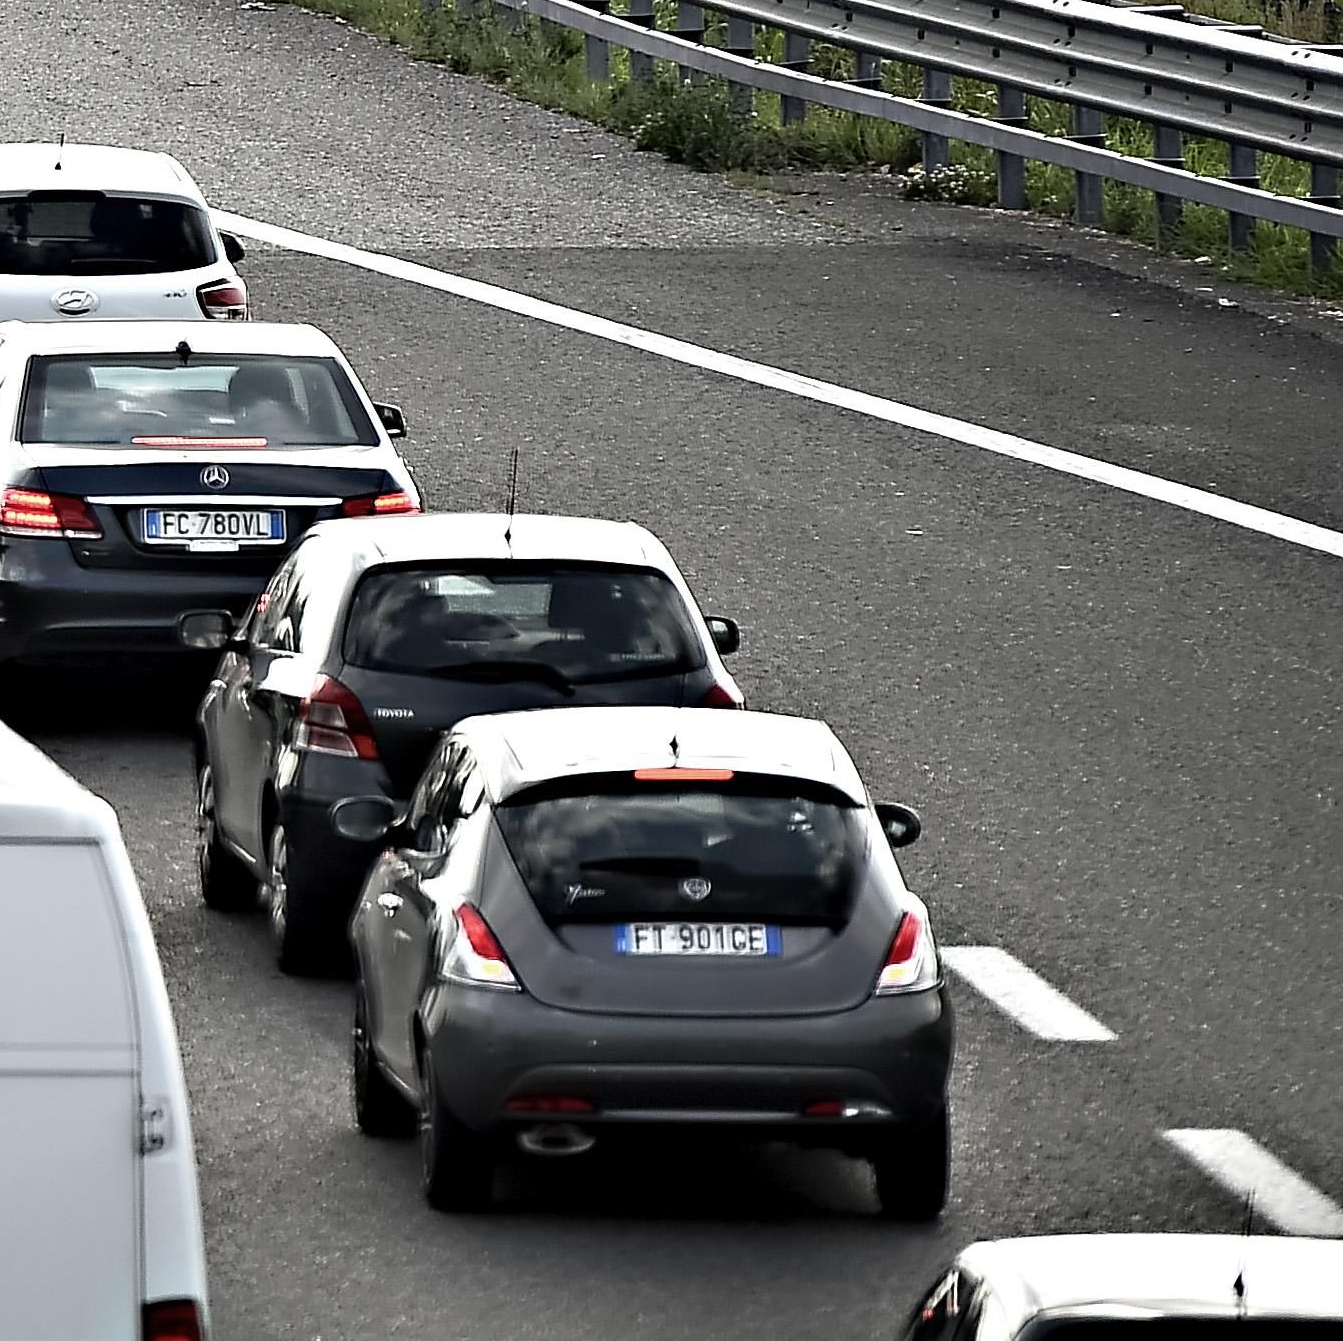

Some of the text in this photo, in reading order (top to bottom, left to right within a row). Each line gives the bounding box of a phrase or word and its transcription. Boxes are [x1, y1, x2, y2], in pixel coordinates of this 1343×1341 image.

[162, 512, 269, 536] FC 780VL
[374, 707, 414, 718] TOYOTA
[633, 923, 667, 951] FT
